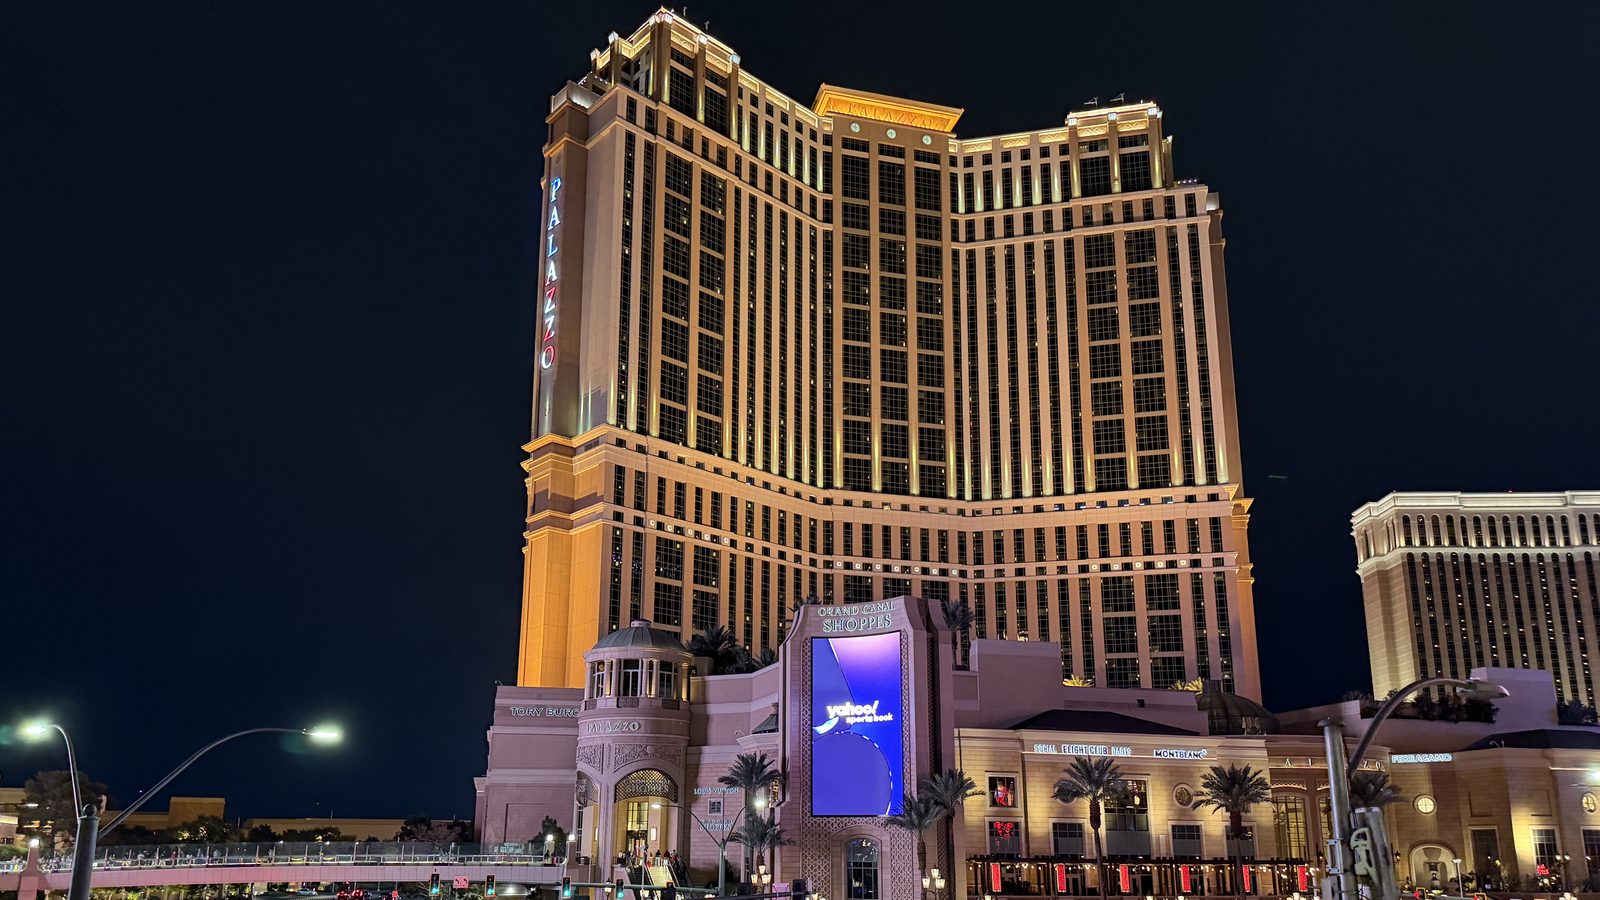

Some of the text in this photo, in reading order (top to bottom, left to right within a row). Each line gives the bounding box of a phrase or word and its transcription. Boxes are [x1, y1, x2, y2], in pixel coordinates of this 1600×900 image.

[541, 177, 561, 369] PALAZZO
[818, 601, 894, 616] GRAND CANAL
[823, 614, 892, 632] SHOPPES
[510, 707, 543, 717] TORY
[826, 700, 879, 719] yahoo!
[845, 712, 893, 725] sports book
[587, 722, 640, 733] PALAZZO
[1089, 745, 1108, 755] CLUB
[1154, 749, 1203, 759] MONTBLANC
[1392, 753, 1452, 763] FERRAGAMO
